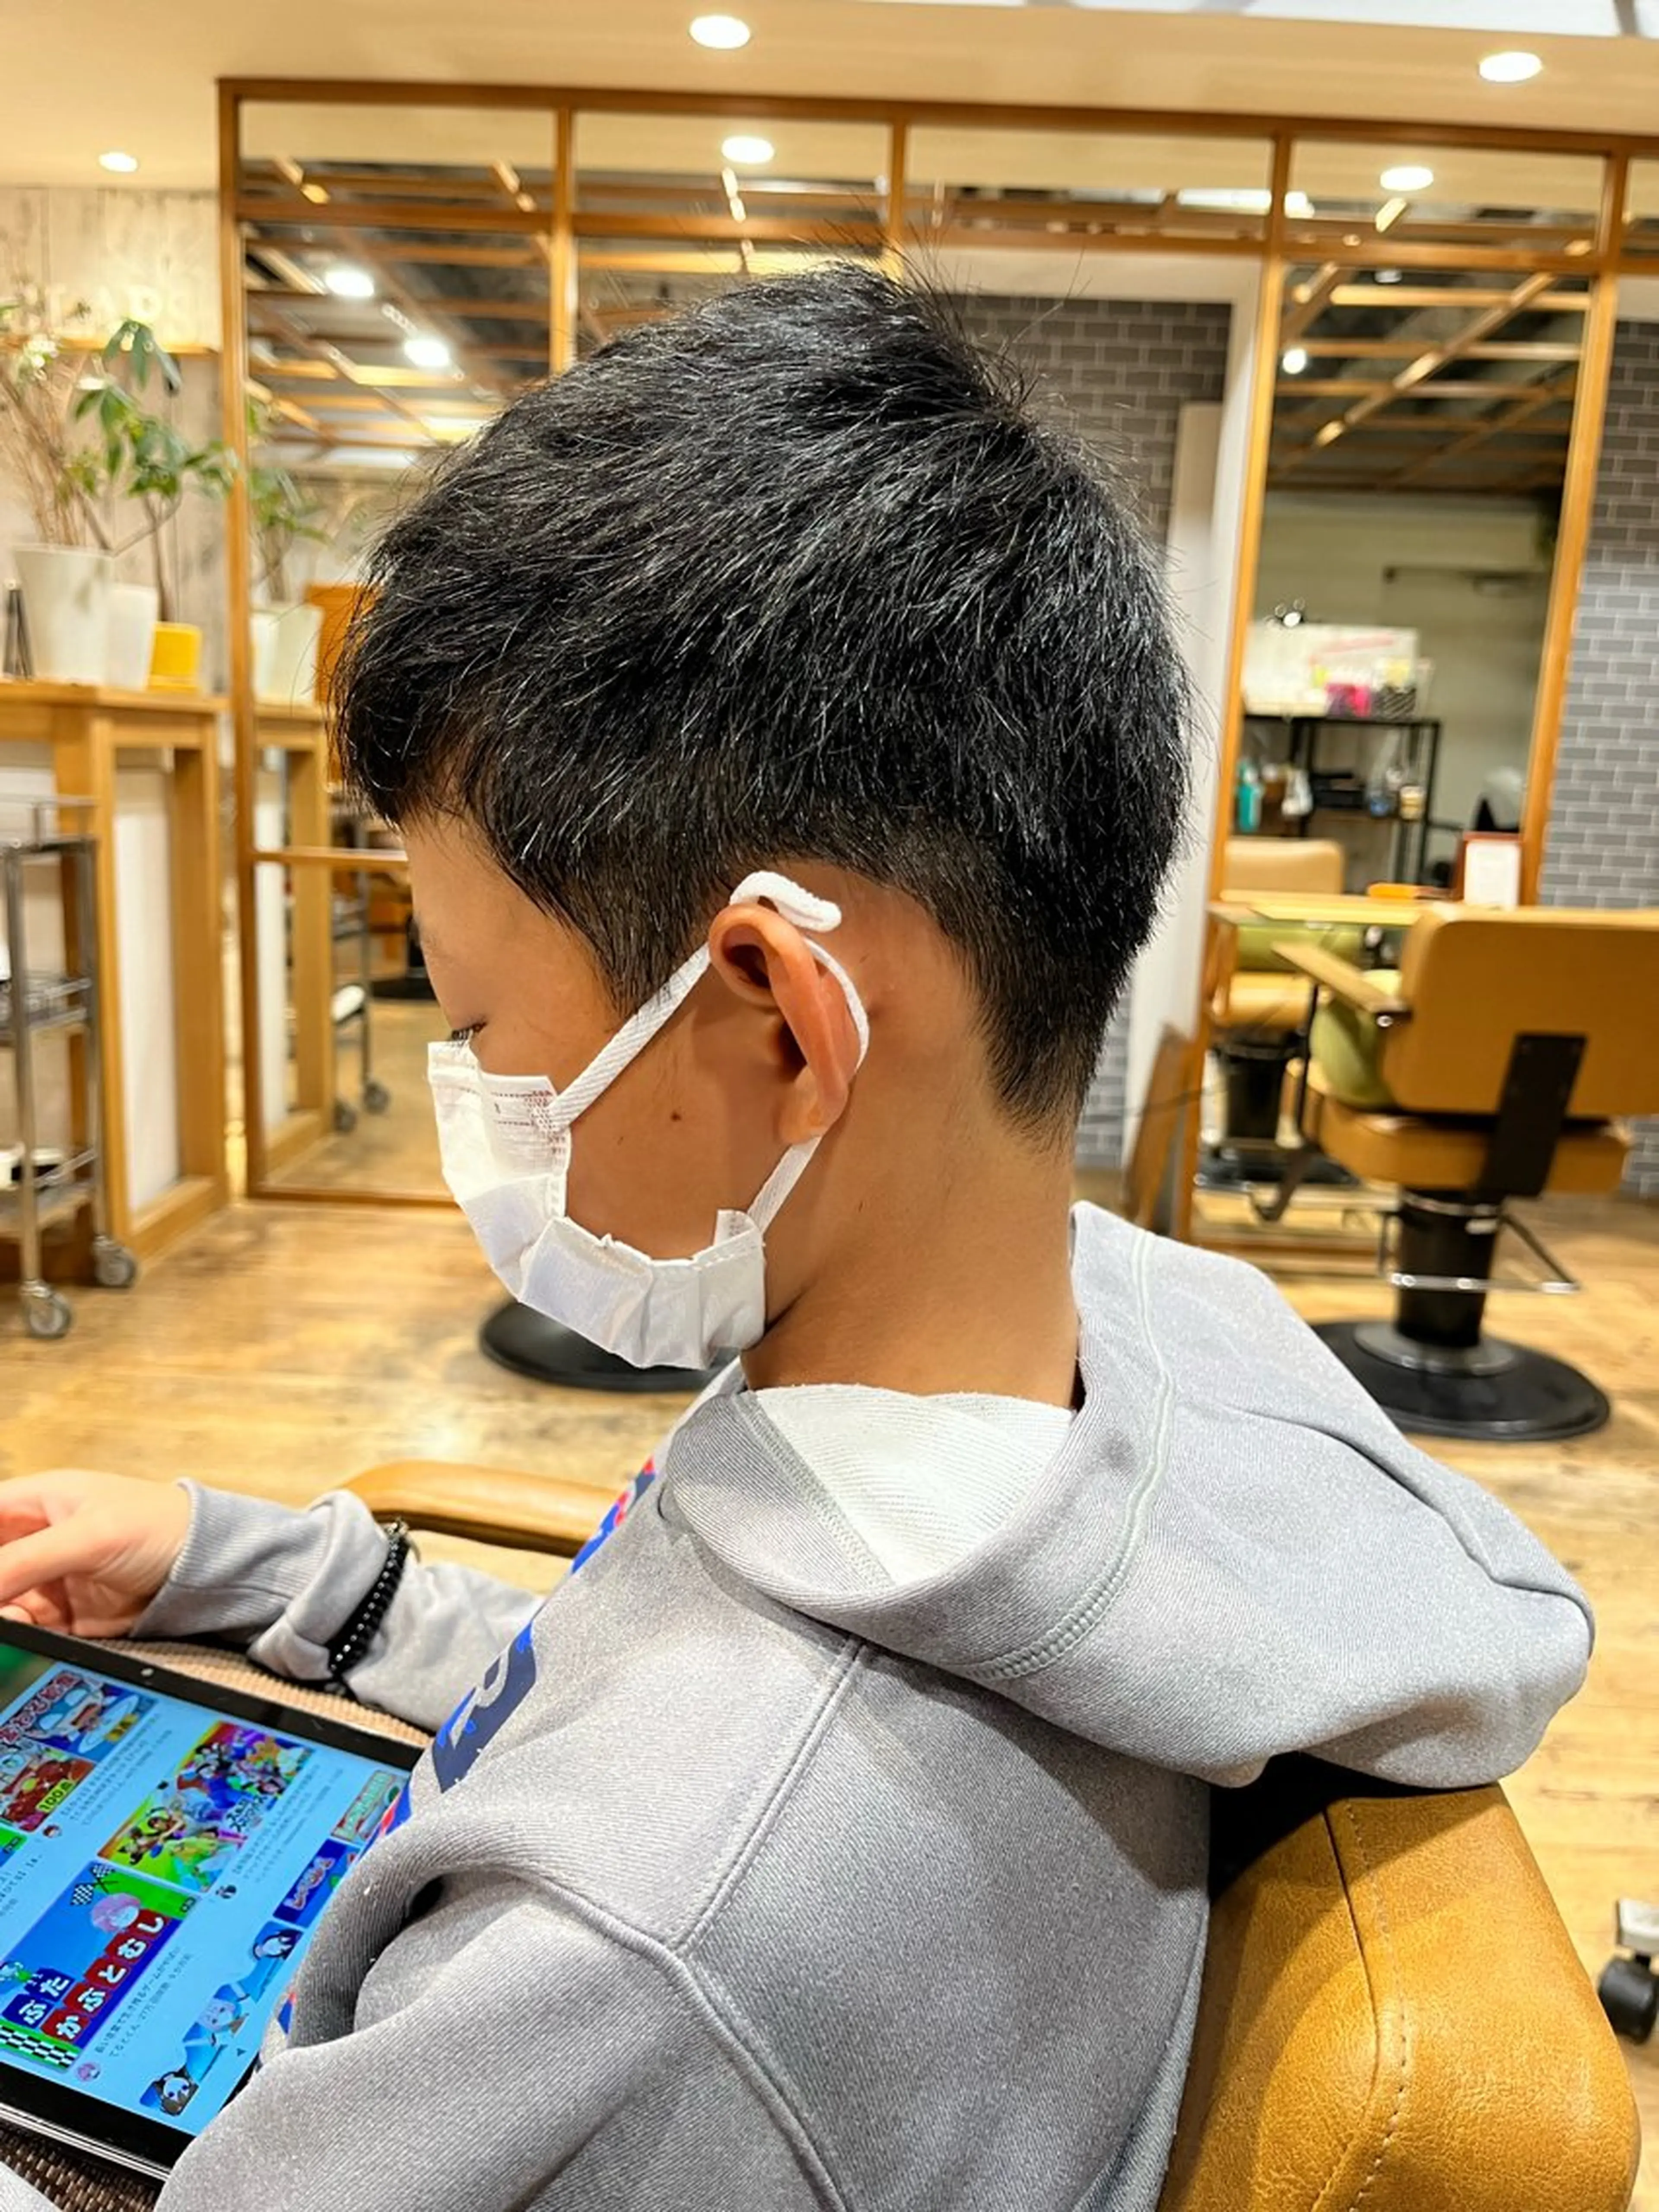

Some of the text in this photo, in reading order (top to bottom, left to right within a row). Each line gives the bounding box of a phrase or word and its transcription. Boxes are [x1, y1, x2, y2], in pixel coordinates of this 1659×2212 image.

[19, 1978, 69, 2023] ぶた
[57, 1917, 163, 2038] かぶとむし
